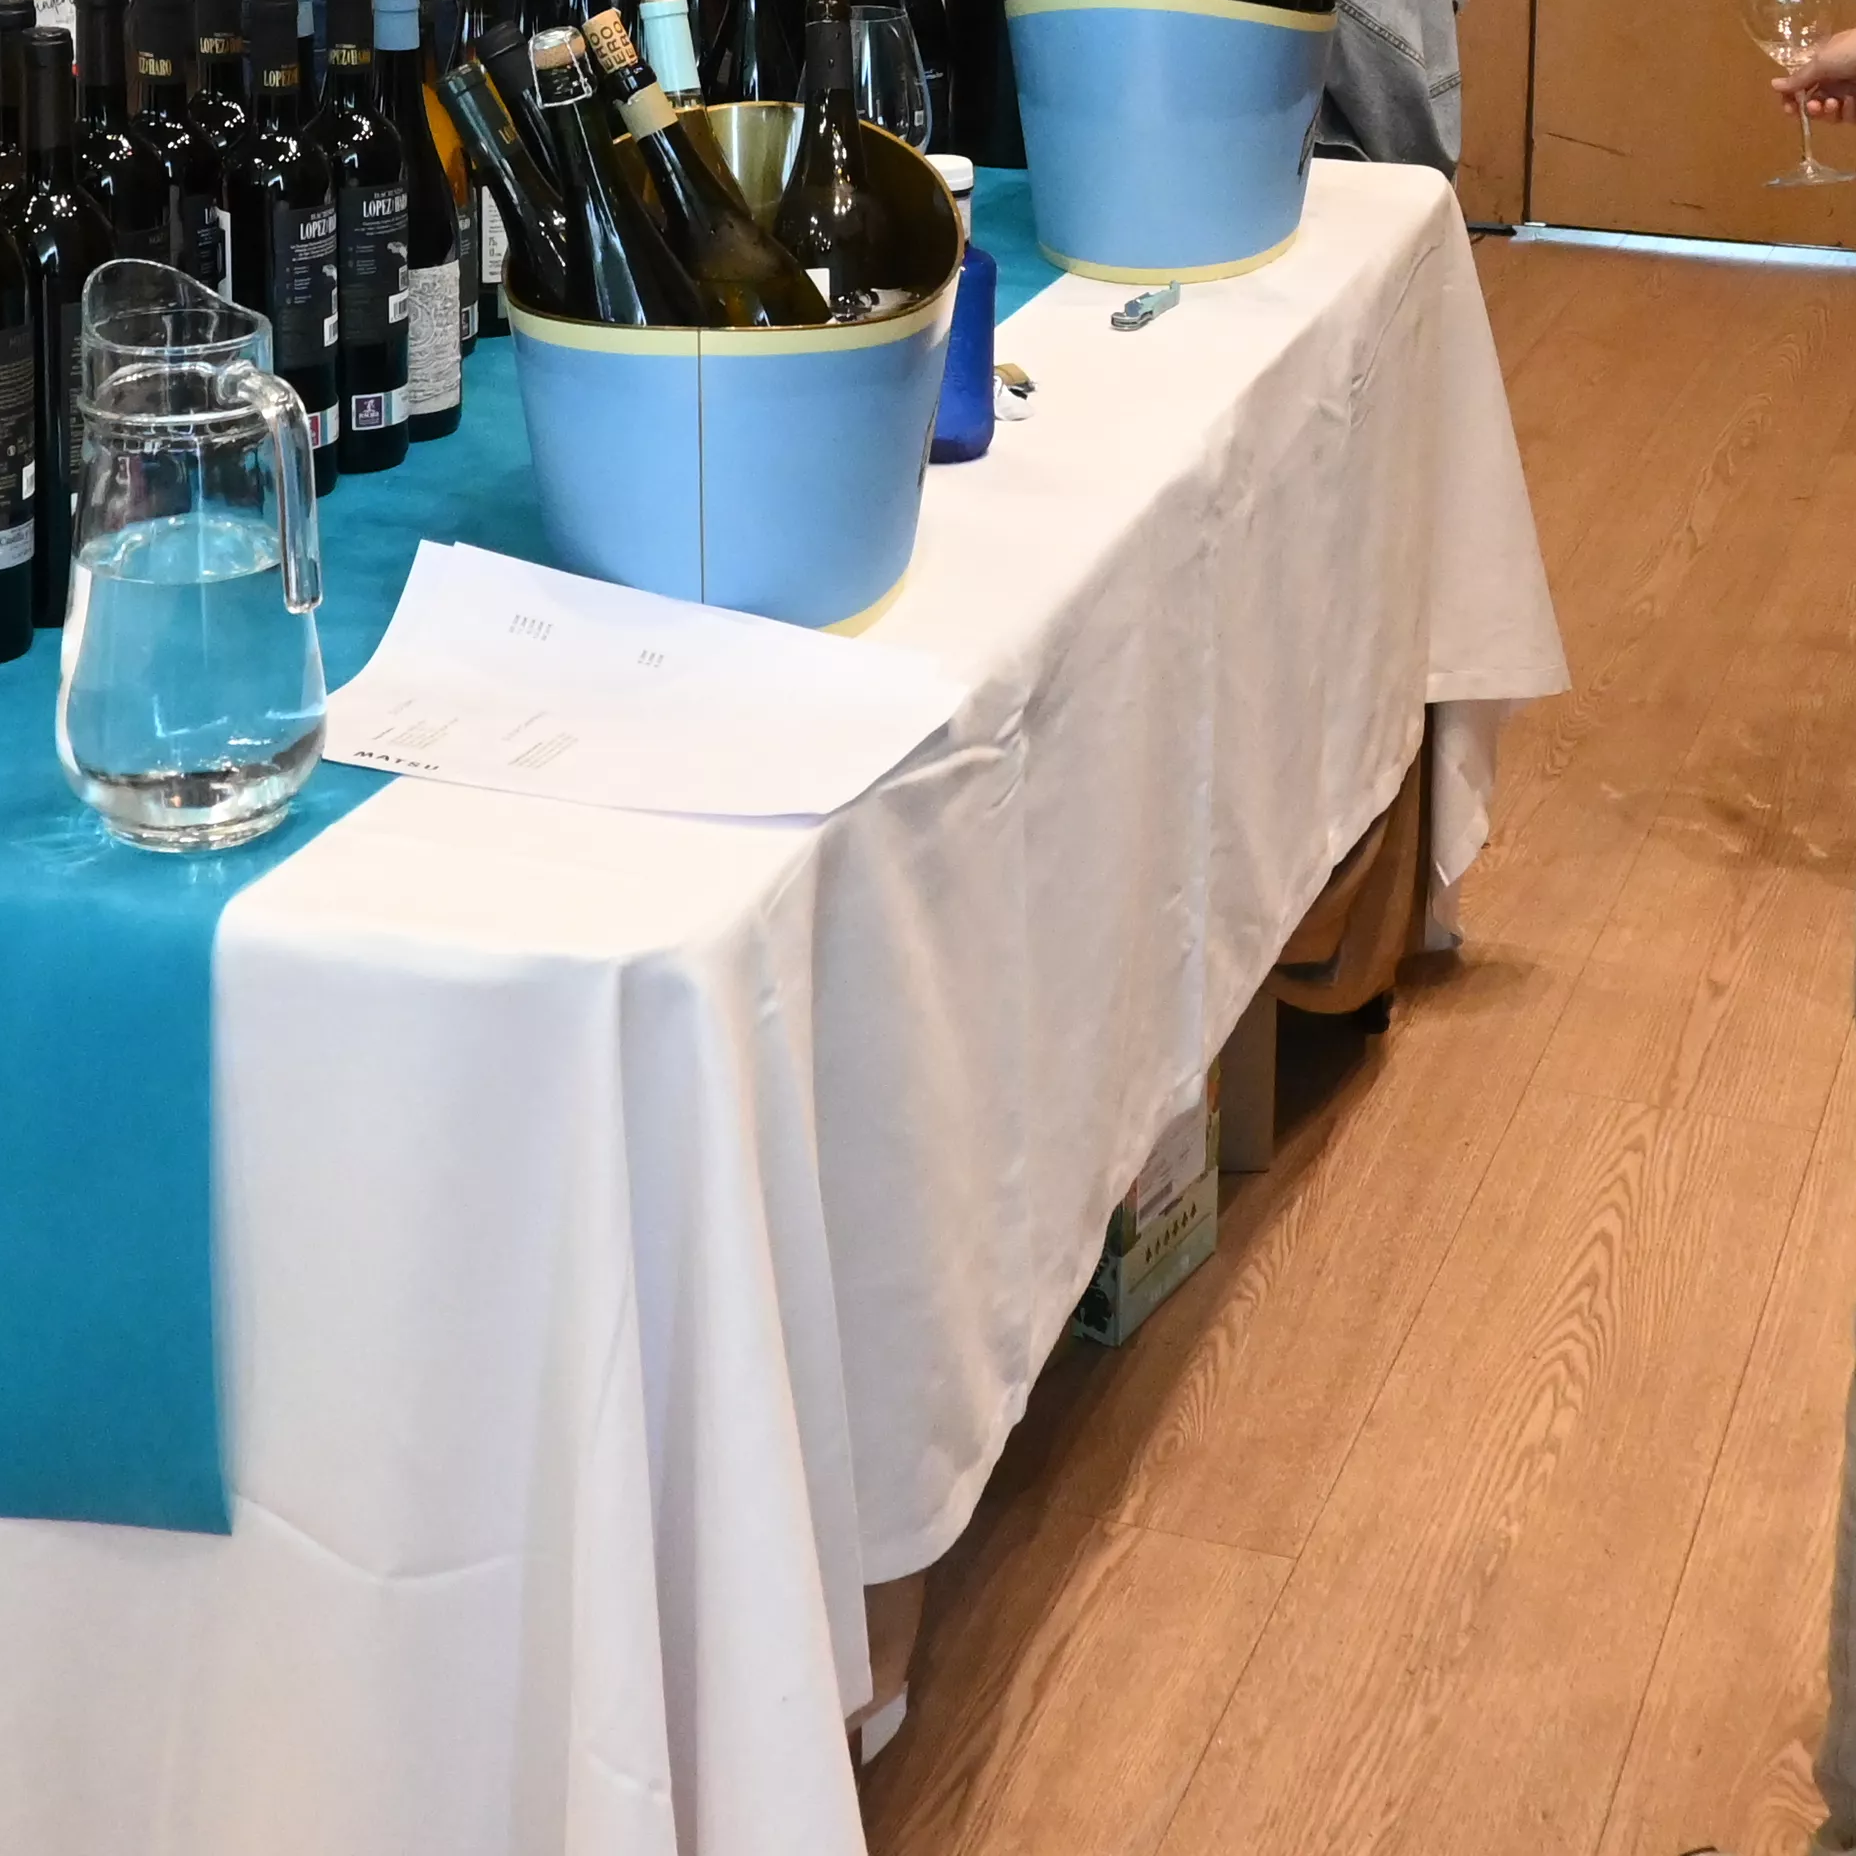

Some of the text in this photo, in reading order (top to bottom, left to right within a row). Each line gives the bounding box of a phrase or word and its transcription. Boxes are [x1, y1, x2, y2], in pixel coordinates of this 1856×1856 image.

[362, 197, 393, 219] LOPEZ
[299, 219, 326, 241] LOPEZ
[352, 750, 441, 772] MATSU
